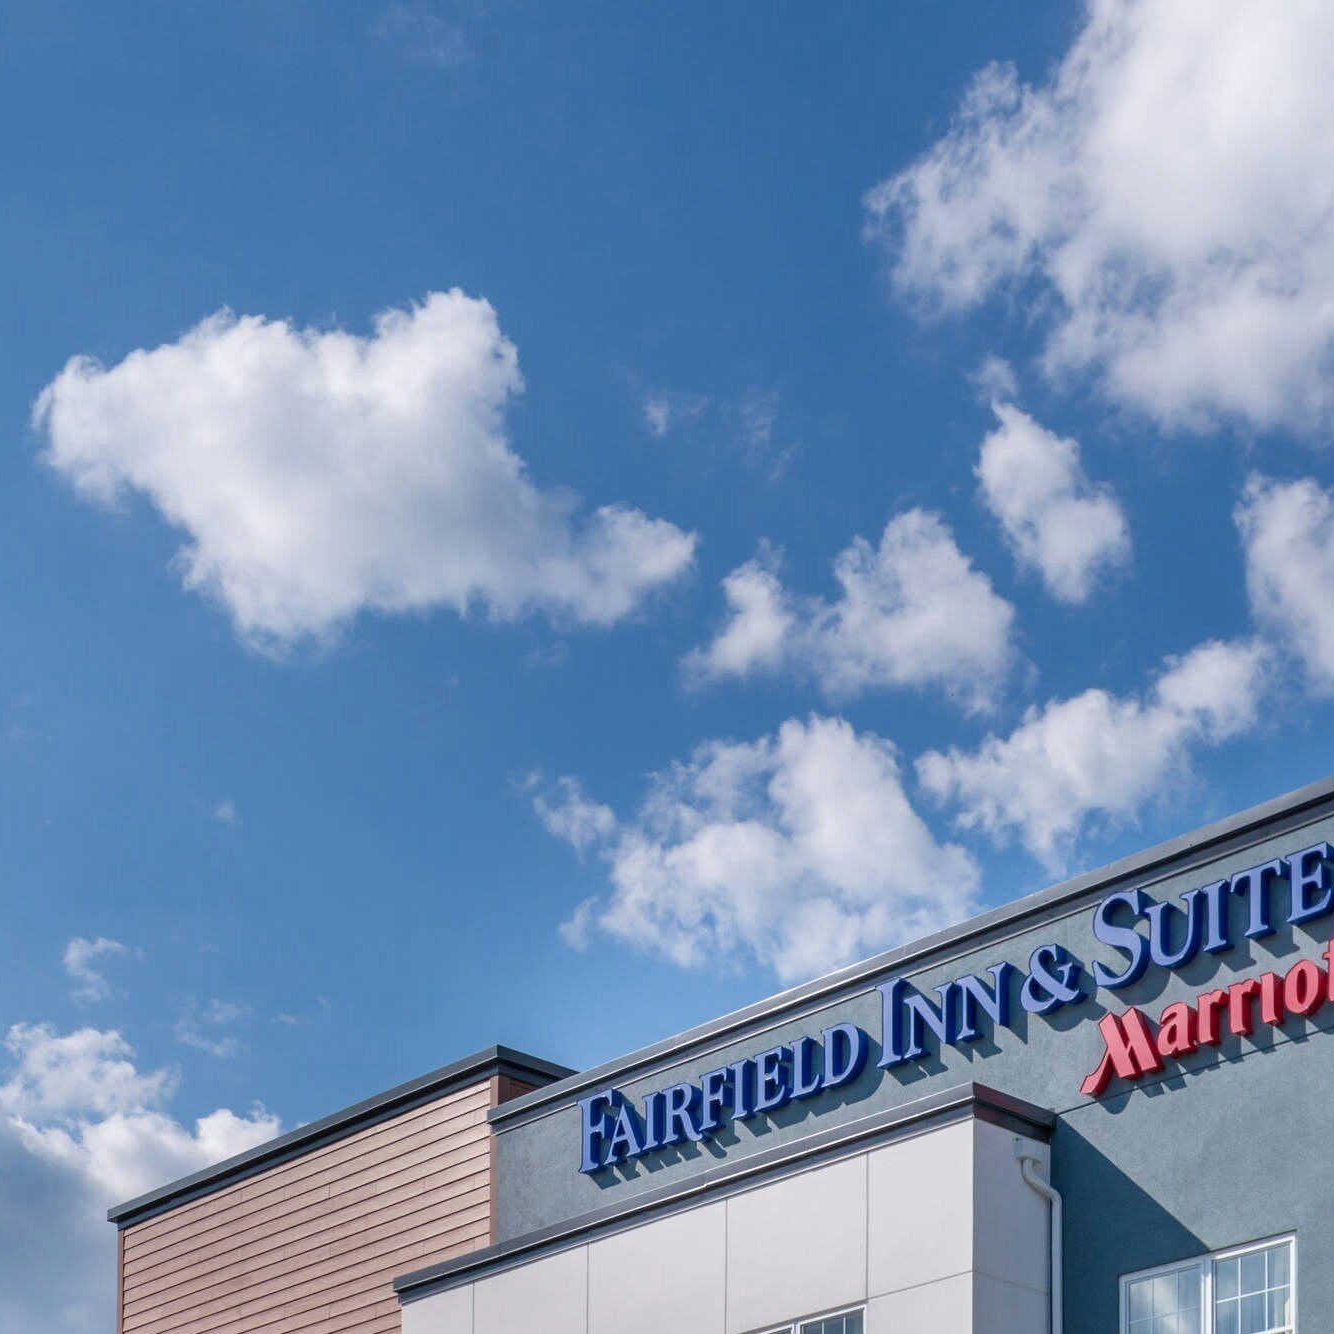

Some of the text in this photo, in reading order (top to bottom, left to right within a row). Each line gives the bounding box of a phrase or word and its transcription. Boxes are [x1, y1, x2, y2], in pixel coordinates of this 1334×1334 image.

[578, 1022, 867, 1175] FAIRFIELD
[875, 961, 1015, 1070] INN
[1020, 943, 1088, 1016] &
